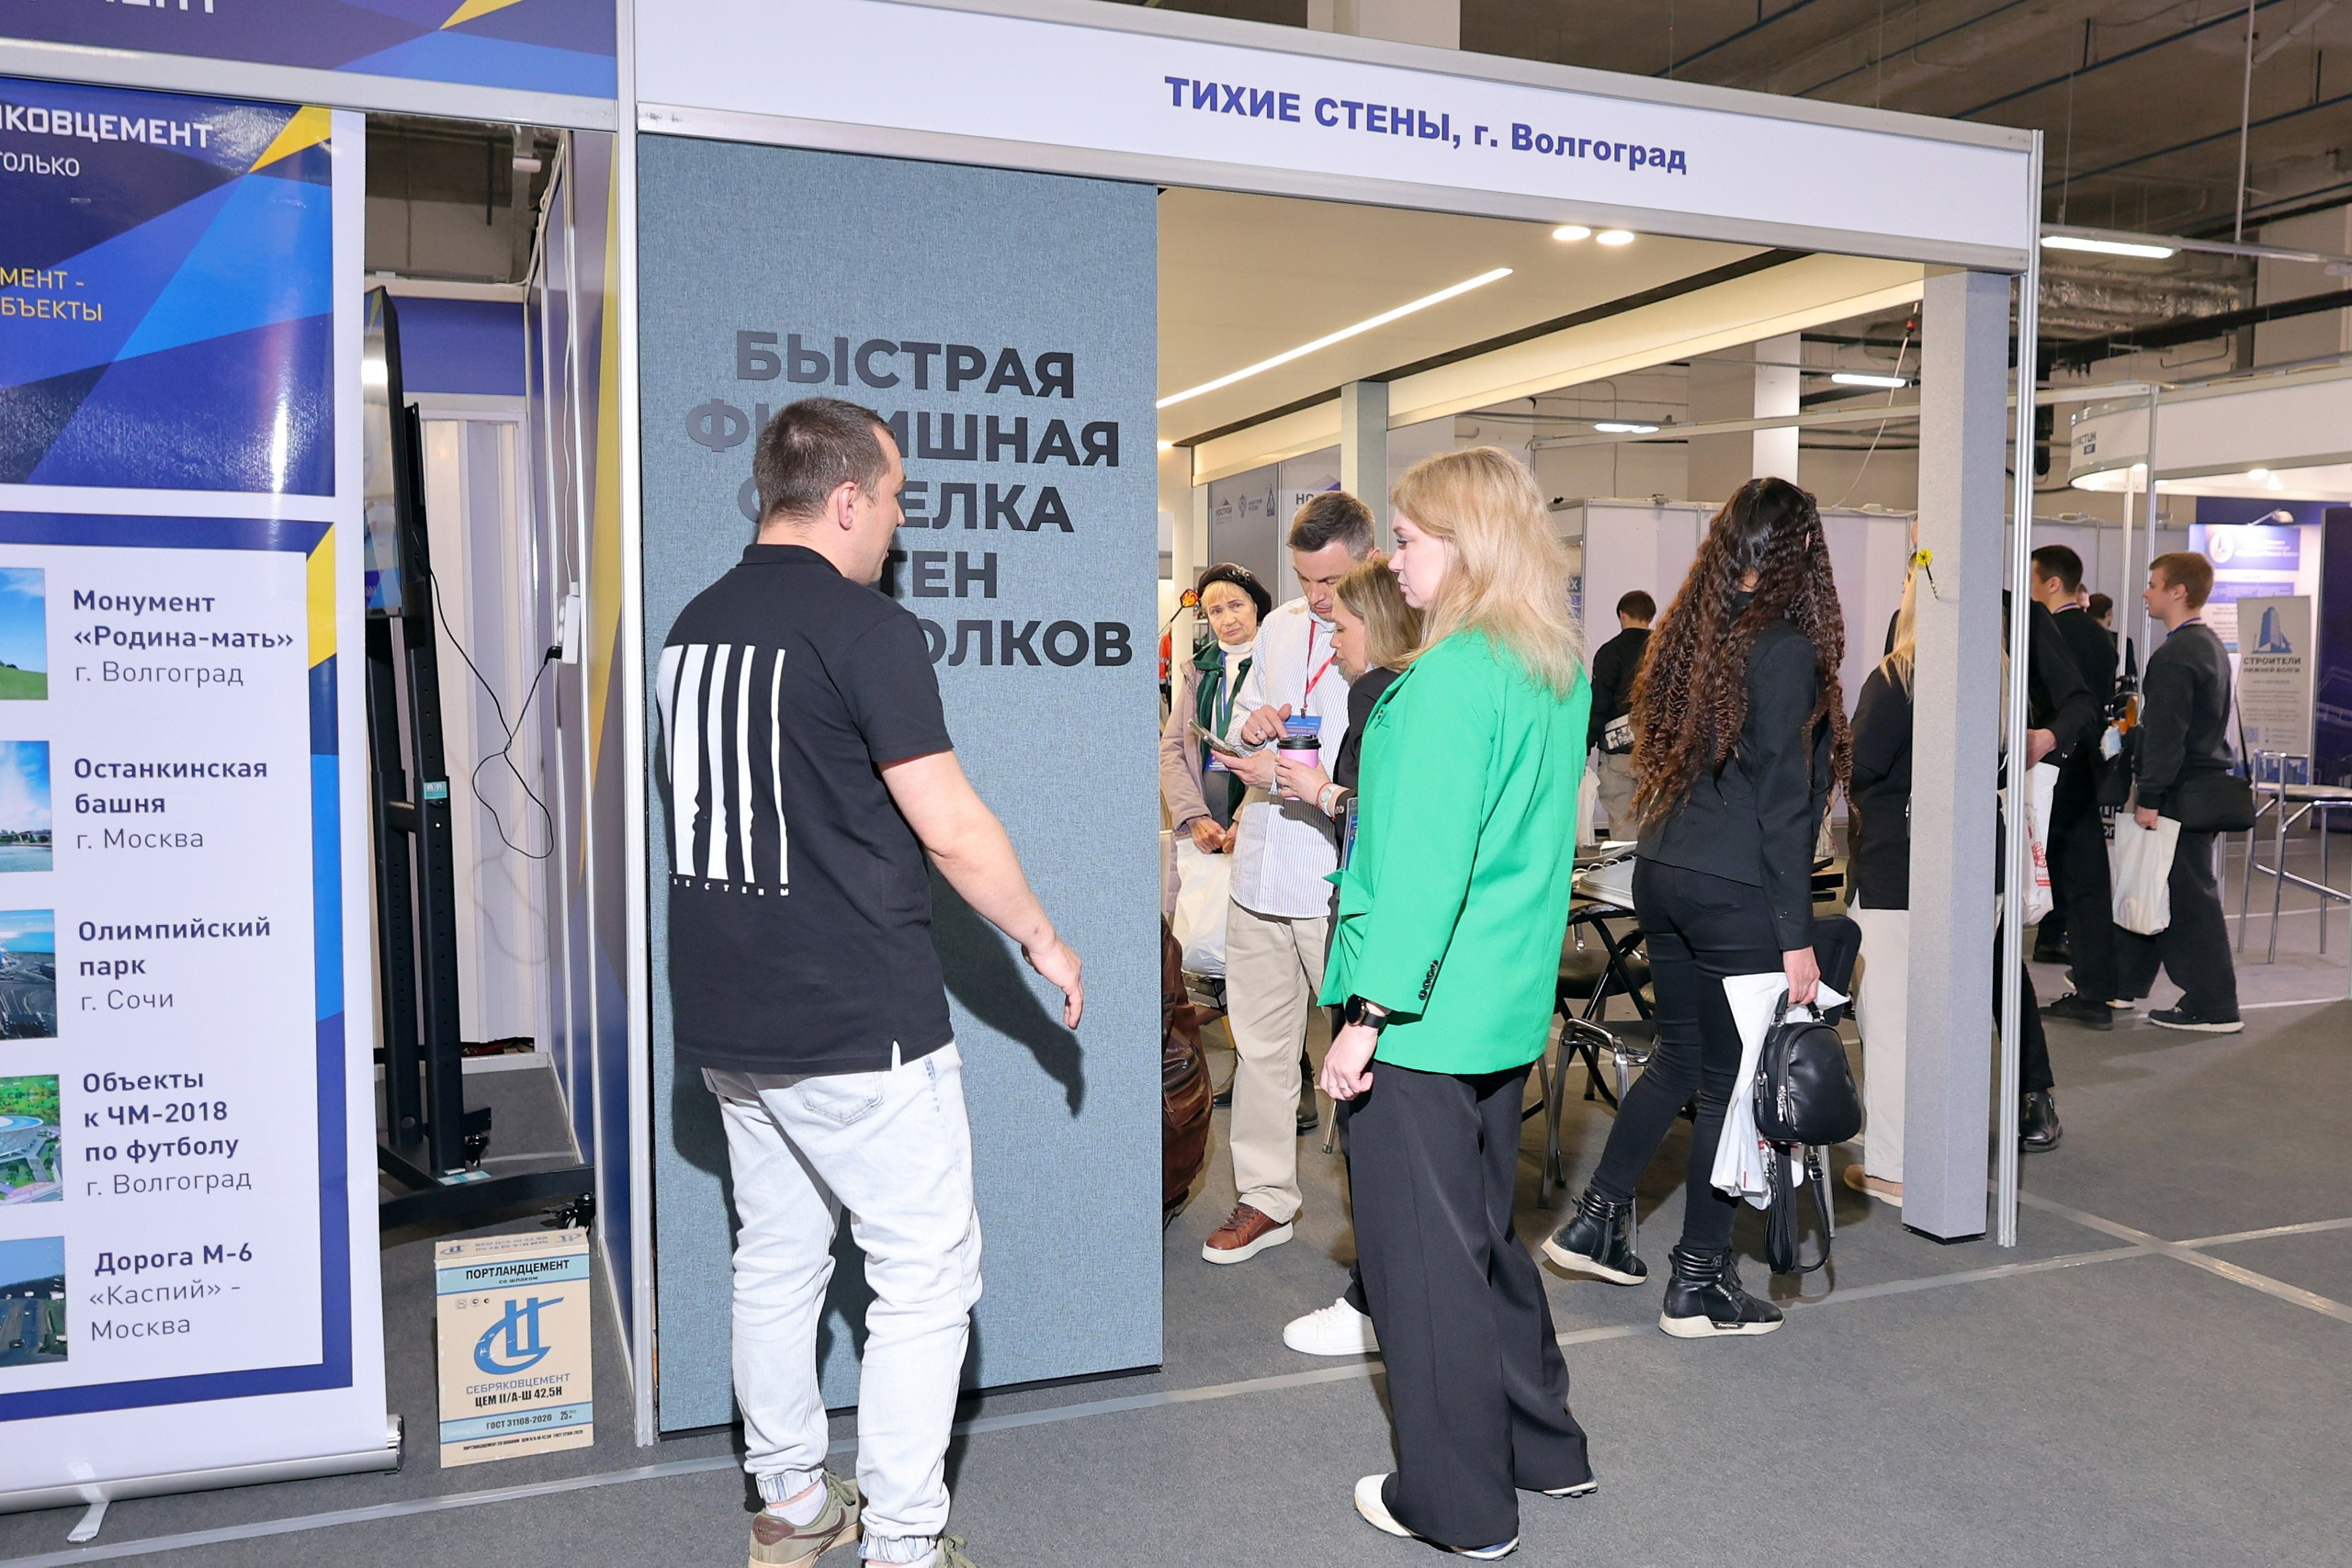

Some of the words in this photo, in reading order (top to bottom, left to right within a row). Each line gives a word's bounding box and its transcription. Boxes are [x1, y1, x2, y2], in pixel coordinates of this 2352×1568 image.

[0, 105, 213, 149] КОВЦЕМЕНТ
[1164, 76, 1301, 123] ТИХИЕ
[1314, 96, 1461, 149] СТЕНЫ,
[1473, 124, 1498, 148] г.
[1510, 122, 1688, 175] Волгоград
[736, 330, 1075, 399] БЫСТРАЯ
[686, 398, 1120, 468] ФИШНАЯ
[880, 550, 998, 599] ТЕН
[74, 589, 216, 616] Монумент
[74, 625, 294, 650] «Родина-мать»
[2243, 657, 2301, 665] СТРОИТЕЛИ
[75, 666, 92, 682] г.
[102, 660, 244, 688] Волгоград
[74, 758, 268, 779] Останкинская
[74, 793, 166, 814] башня
[76, 833, 93, 850] г.
[103, 828, 204, 849] Москва
[78, 916, 271, 942] Олимпийский
[79, 958, 147, 980] парк
[81, 996, 97, 1011] г.
[107, 989, 174, 1010] Сочи
[83, 1072, 205, 1093] Объекты
[84, 1111, 100, 1128] к
[107, 1101, 229, 1126] ЧМ-2018
[85, 1145, 118, 1163] по
[126, 1136, 240, 1164] футболу
[86, 1180, 103, 1196] г.
[113, 1172, 253, 1195] Волгоград
[94, 1250, 194, 1277] Дорога
[202, 1242, 254, 1265] М-6
[465, 1259, 571, 1280] ПОРТЛАНДЦЕМЕНТ
[508, 1275, 539, 1284] шлаком
[89, 1279, 222, 1305] «Каспий»
[91, 1318, 191, 1342] Москва
[466, 1372, 571, 1395] СЕБРЯКОВЦЕМЕНТ
[475, 1393, 497, 1408] ЦЕМ
[534, 1385, 563, 1400] 42,5Н
[485, 1418, 506, 1431] ГОСТ
[506, 1413, 553, 1428] 31108-2020
[560, 1410, 569, 1421] 25
